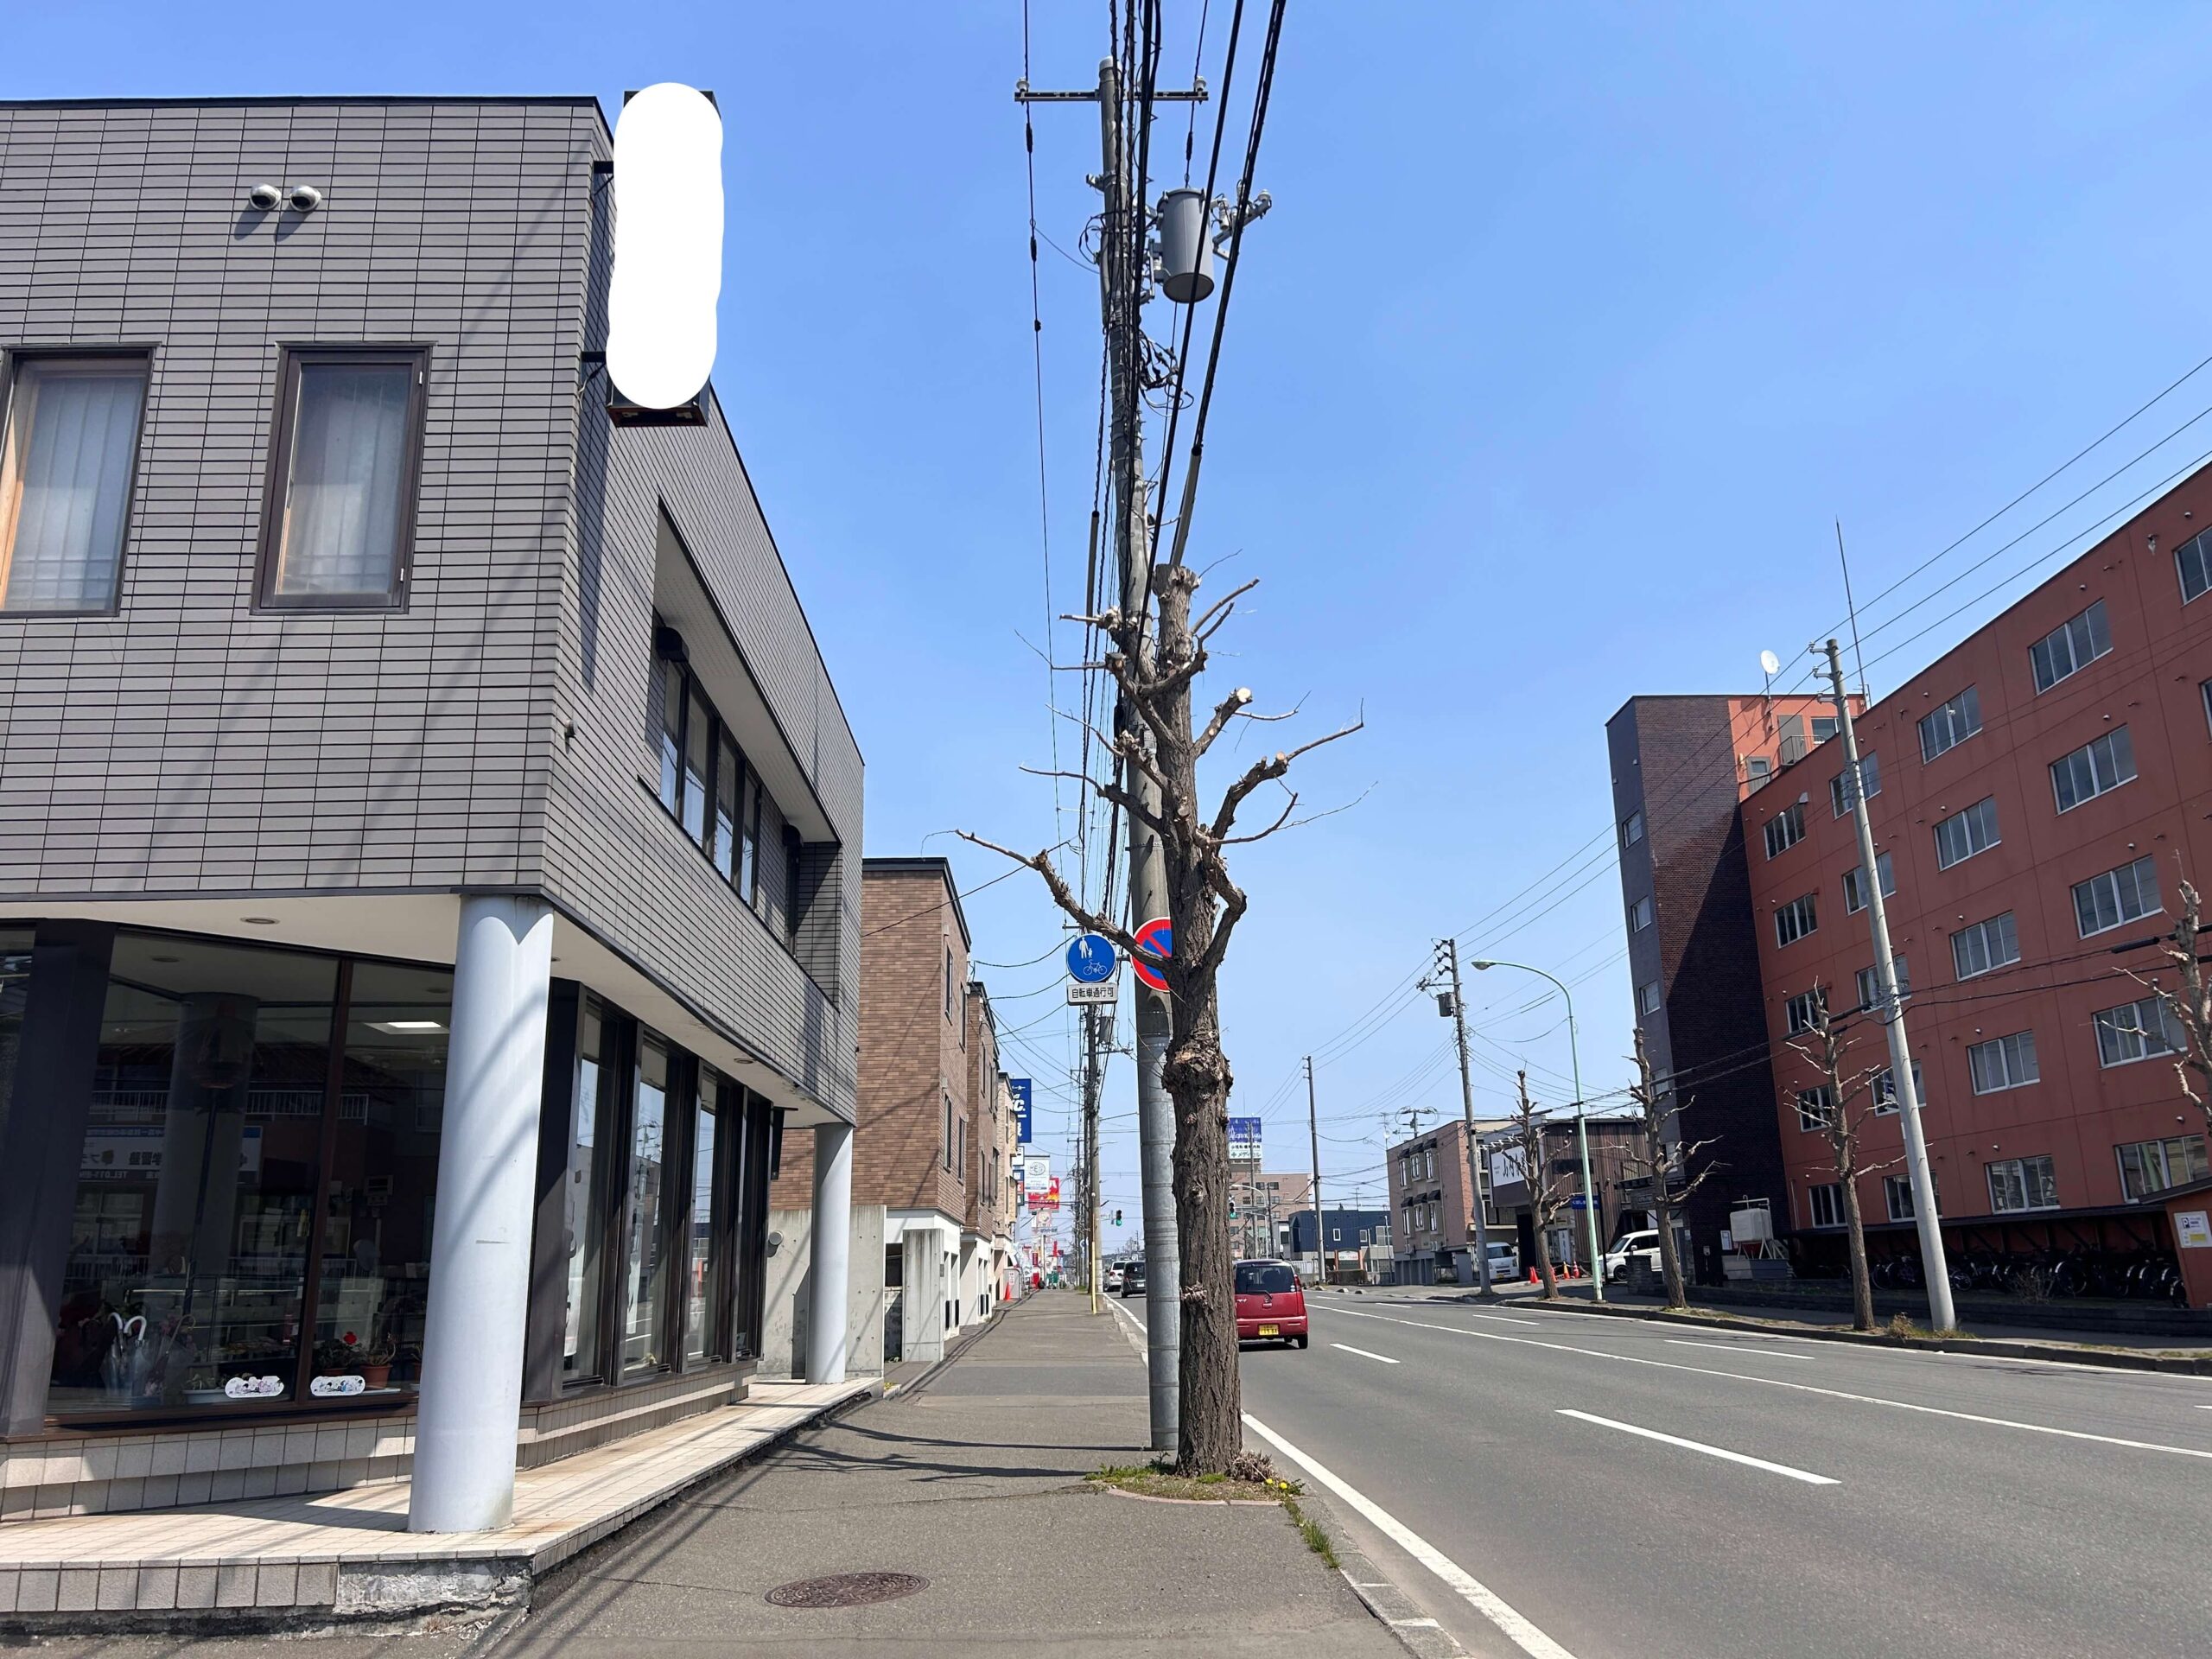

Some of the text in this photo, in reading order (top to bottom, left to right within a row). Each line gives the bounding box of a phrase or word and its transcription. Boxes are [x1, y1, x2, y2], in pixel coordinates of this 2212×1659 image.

[1071, 987, 1114, 999] 自転車通行可
